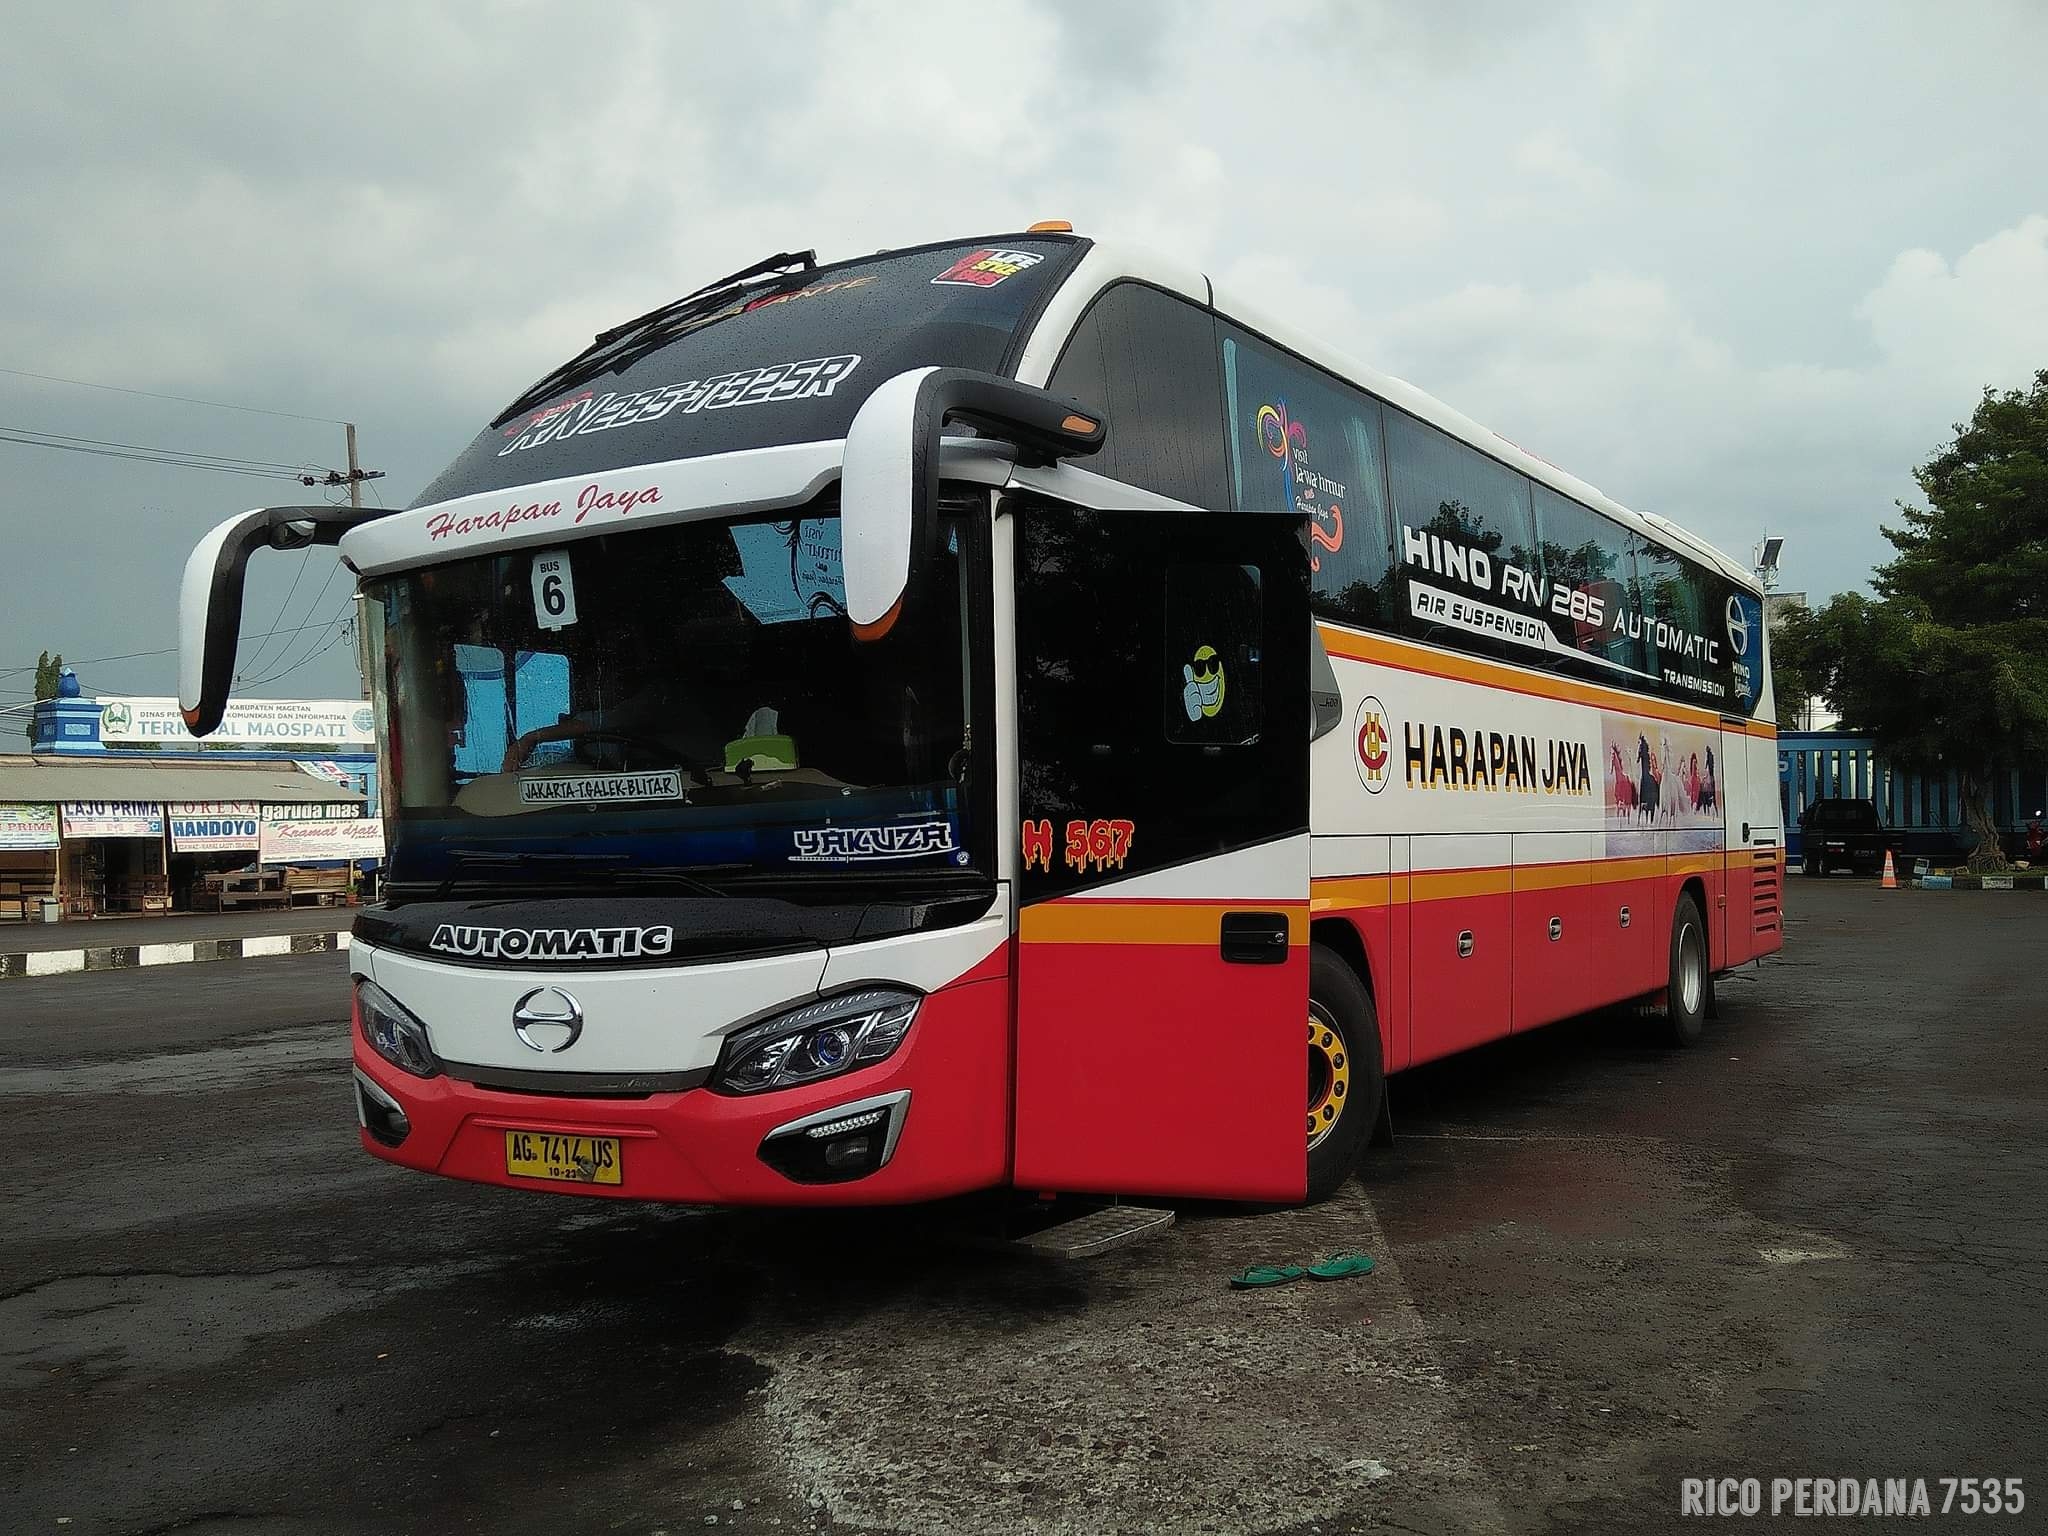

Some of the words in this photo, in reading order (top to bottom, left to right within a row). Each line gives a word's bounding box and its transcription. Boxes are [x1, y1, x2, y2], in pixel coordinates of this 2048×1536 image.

[426, 501, 561, 542] Harapan
[575, 484, 663, 524] Jaya
[539, 560, 560, 574] BUS
[542, 574, 566, 616] 6
[1404, 525, 1492, 591] HINO
[1501, 564, 1545, 607] RN
[1551, 582, 1605, 627] 285
[1612, 607, 1719, 665] AUTOMATIC
[1417, 591, 1446, 617] AIR
[1451, 603, 1546, 642] SUSPENSION
[1732, 660, 1750, 679] HINO
[1663, 667, 1725, 697] TRANSMISSION
[229, 704, 274, 712] KABUPATEN
[247, 722, 347, 737] MAOSPATI
[1404, 721, 1537, 793] HARAPAN
[1541, 738, 1592, 795] JAYA
[65, 800, 106, 817] LAJU
[112, 800, 160, 817] PRIMA
[169, 800, 257, 814] LORENA
[325, 803, 361, 818] mas
[172, 820, 257, 837] HANDOYO
[277, 824, 338, 839] Kramat
[793, 822, 953, 856] YAKUZA
[1022, 819, 1053, 874] H
[1065, 819, 1135, 874] 567
[429, 924, 674, 960] AUTOMATIC
[512, 1134, 533, 1161] AG
[540, 1136, 584, 1166] 7414
[591, 1139, 613, 1168] US
[548, 1166, 577, 1179] 10-23
